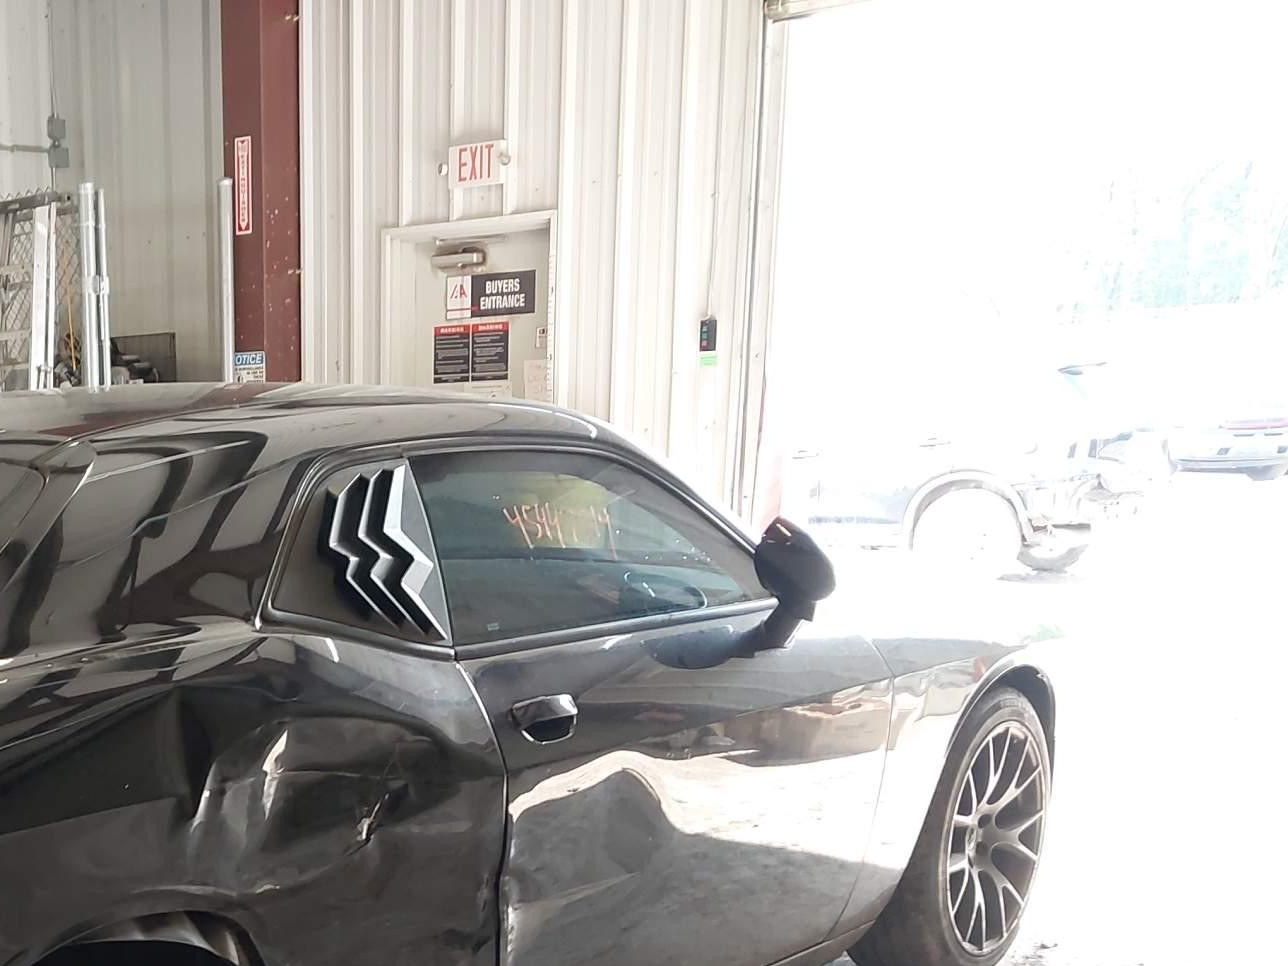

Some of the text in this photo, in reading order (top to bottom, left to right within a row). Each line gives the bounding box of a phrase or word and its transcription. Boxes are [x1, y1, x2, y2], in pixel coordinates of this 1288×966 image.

[457, 143, 494, 182] EXIT
[485, 278, 521, 295] BUYERS
[479, 293, 525, 310] ENTRANCE
[235, 353, 262, 365] OTICE
